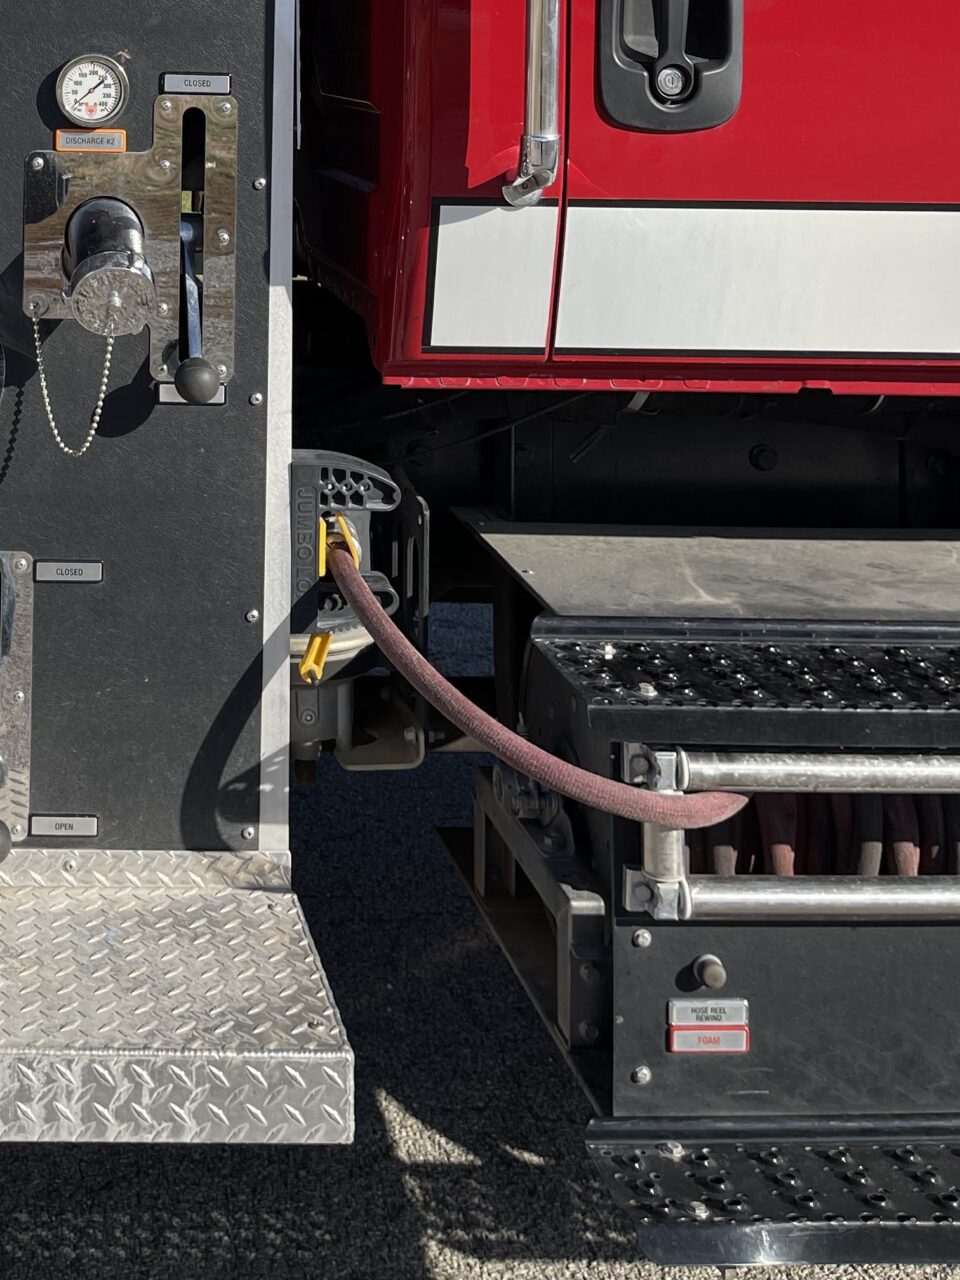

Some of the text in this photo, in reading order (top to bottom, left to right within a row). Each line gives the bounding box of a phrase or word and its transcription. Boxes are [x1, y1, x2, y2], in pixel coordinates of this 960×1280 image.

[184, 79, 211, 87] CLOSED
[65, 137, 115, 145] DISCHARGE #2
[296, 487, 314, 558] JUMBO
[55, 568, 83, 576] CLOSED
[54, 822, 74, 831] OPEN
[695, 1014, 722, 1022] REWIND
[697, 1035, 720, 1045] FOAM
